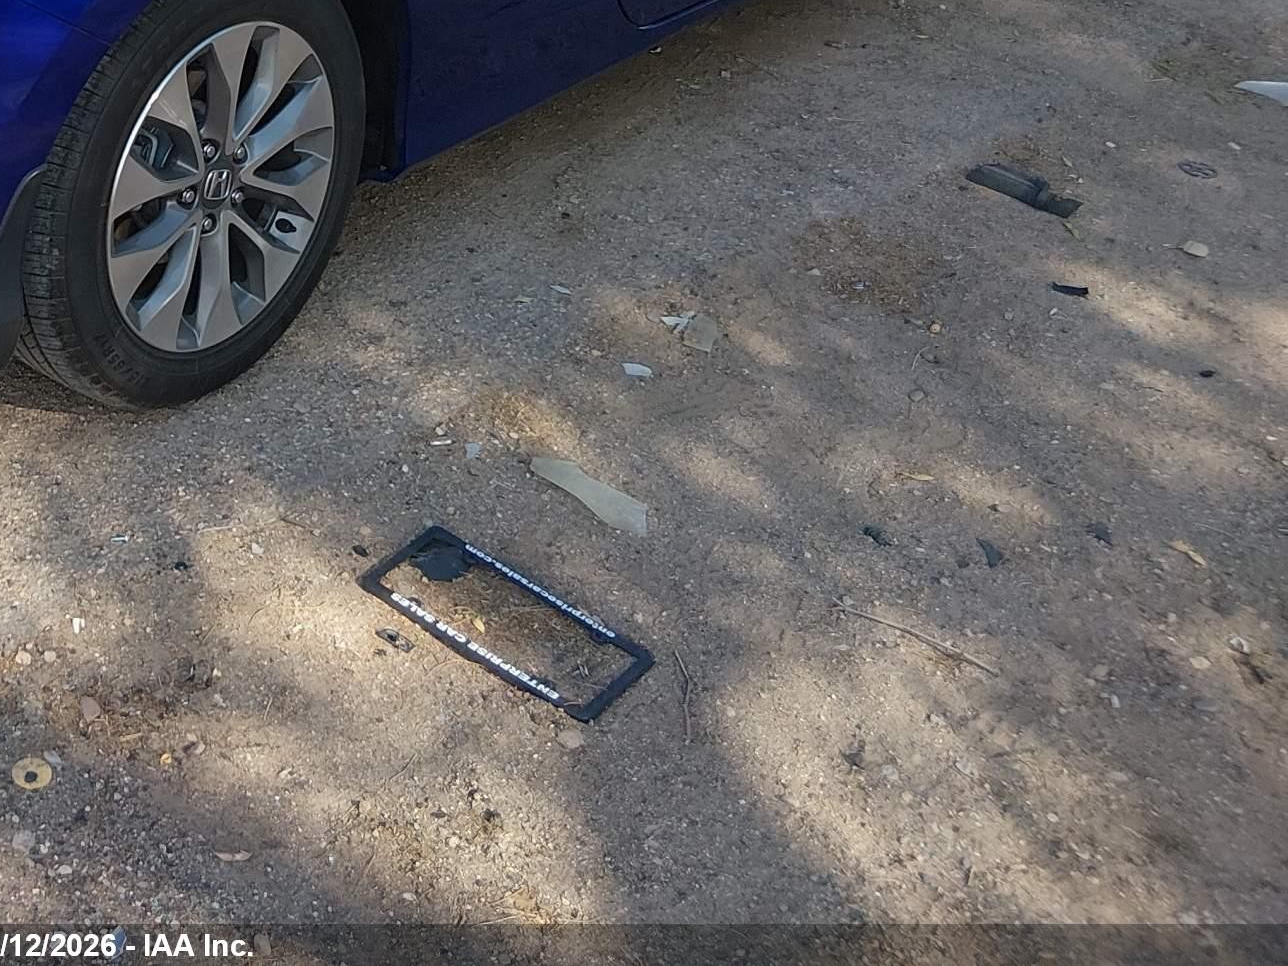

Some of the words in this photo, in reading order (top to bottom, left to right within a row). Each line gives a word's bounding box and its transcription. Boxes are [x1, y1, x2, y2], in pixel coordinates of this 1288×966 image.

[390, 592, 436, 623] SALES
[465, 544, 616, 638] enterprisecarsales.com
[435, 621, 467, 643] CAR
[467, 641, 560, 700] ENTERPRISE
